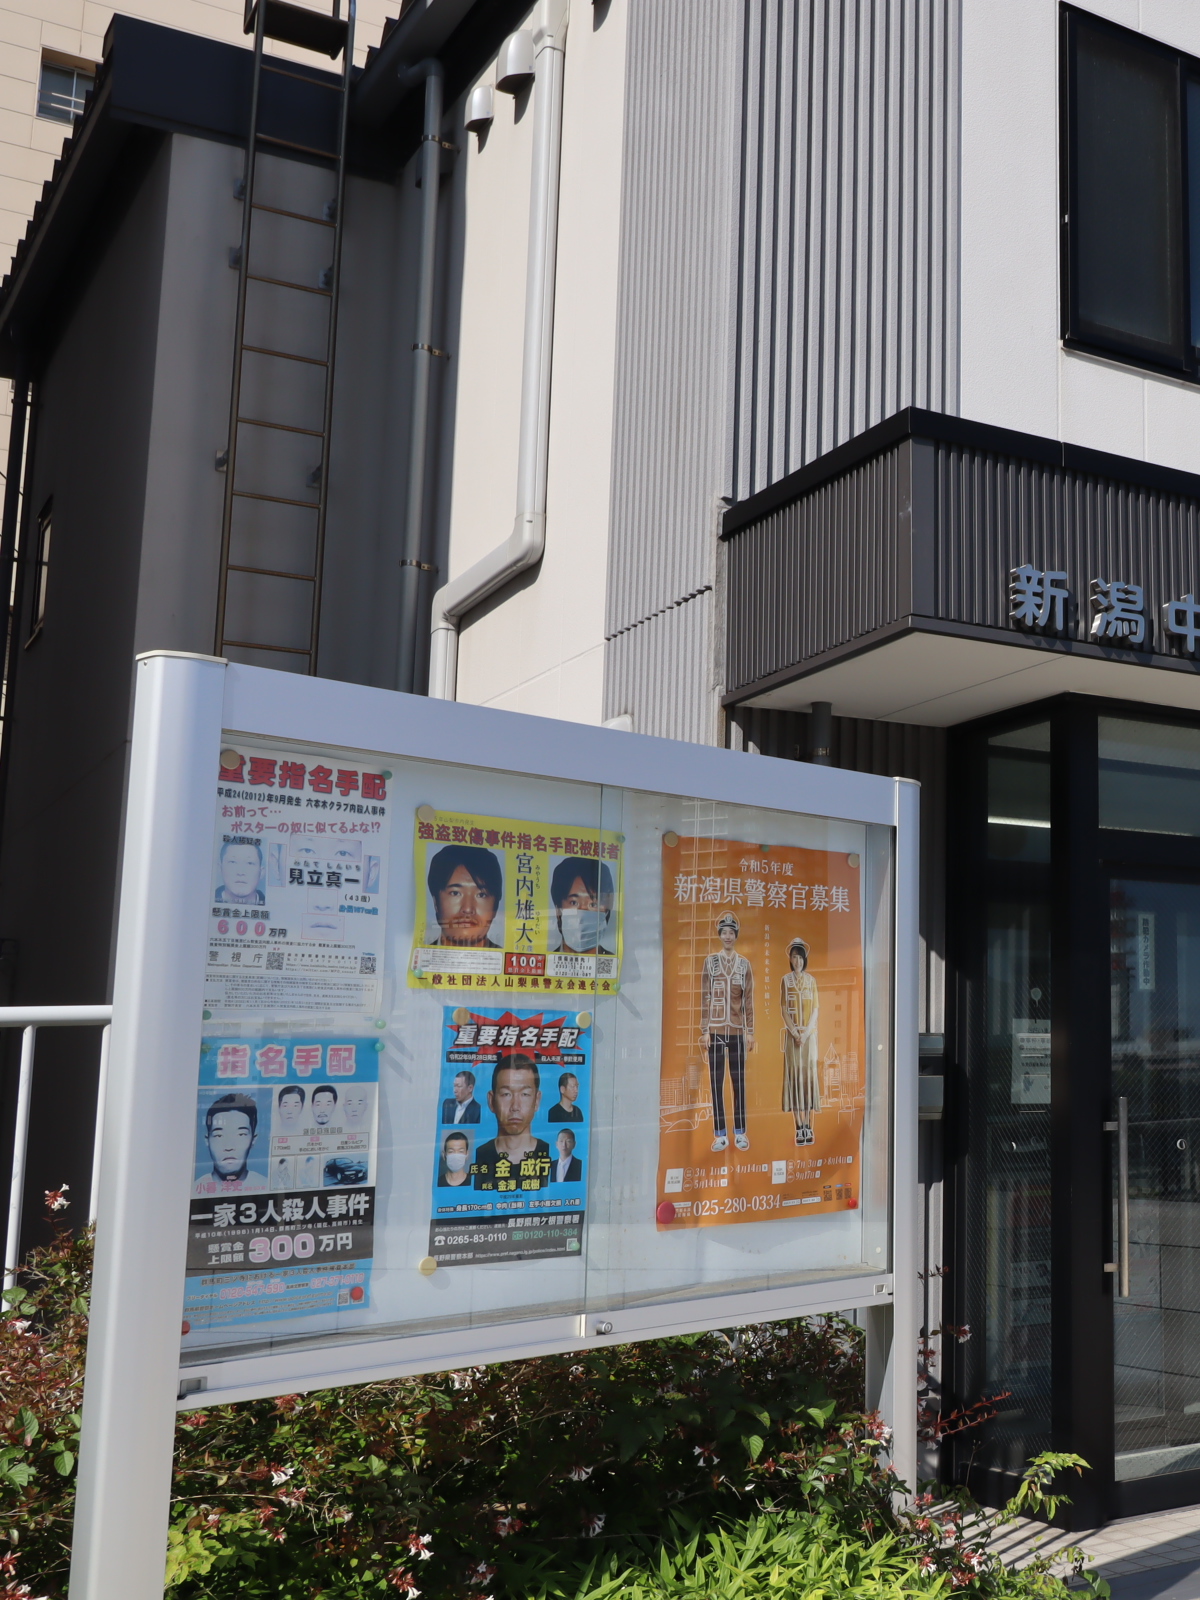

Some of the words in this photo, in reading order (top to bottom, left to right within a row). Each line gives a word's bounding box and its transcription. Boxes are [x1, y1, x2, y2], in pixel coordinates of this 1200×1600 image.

[218, 754, 387, 800] 重要指名手配
[306, 798, 386, 816] 六本木クラブ内殺人事件
[418, 821, 619, 861] 強盗致傷事件指名手配被疑者
[738, 858, 794, 876] 令和5年度
[289, 868, 360, 888] 見立真一
[515, 852, 535, 943] 宮内雄大
[674, 873, 850, 913] 新潟県警察官募集
[212, 907, 270, 920] 懸賞金上限額
[454, 1025, 579, 1048] 重要指名手配
[217, 1045, 356, 1078] 指名手配
[495, 1159, 511, 1177] 金
[520, 1158, 551, 1176] 成行
[191, 1193, 370, 1228] 一家3人殺人事件
[693, 1194, 781, 1216] 025-280-0334
[447, 1232, 507, 1245] 0265-83-0110
[524, 1228, 578, 1240] 0120-110-384
[207, 1241, 245, 1254] 懸賞金
[207, 1252, 245, 1265] 上限額
